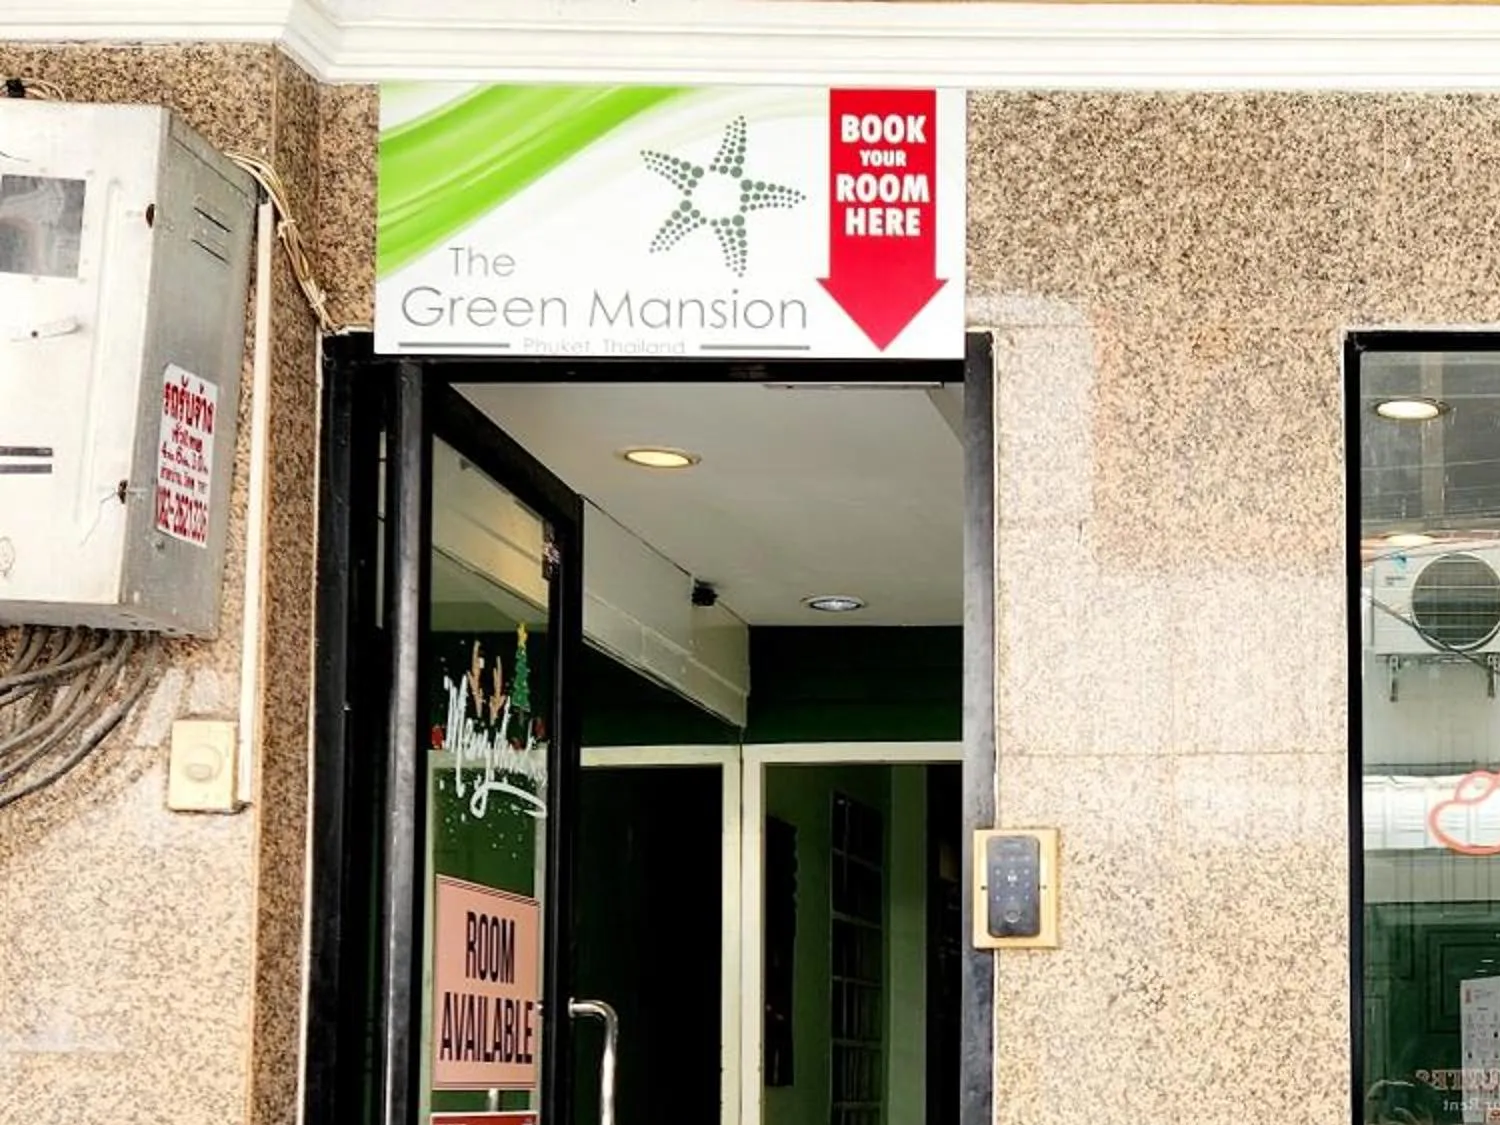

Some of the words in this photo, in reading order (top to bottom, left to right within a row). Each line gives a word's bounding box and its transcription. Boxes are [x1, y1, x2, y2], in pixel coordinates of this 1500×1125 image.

[840, 113, 927, 144] BOOK
[860, 149, 908, 167] YOUR
[836, 173, 930, 203] ROOM
[845, 207, 921, 237] HERE
[448, 246, 517, 278] The
[400, 286, 568, 328] Green
[588, 288, 808, 330] Mansion
[602, 337, 686, 356] Thailand
[466, 911, 515, 985] ROOM
[440, 991, 533, 1064] AVAILABLE
